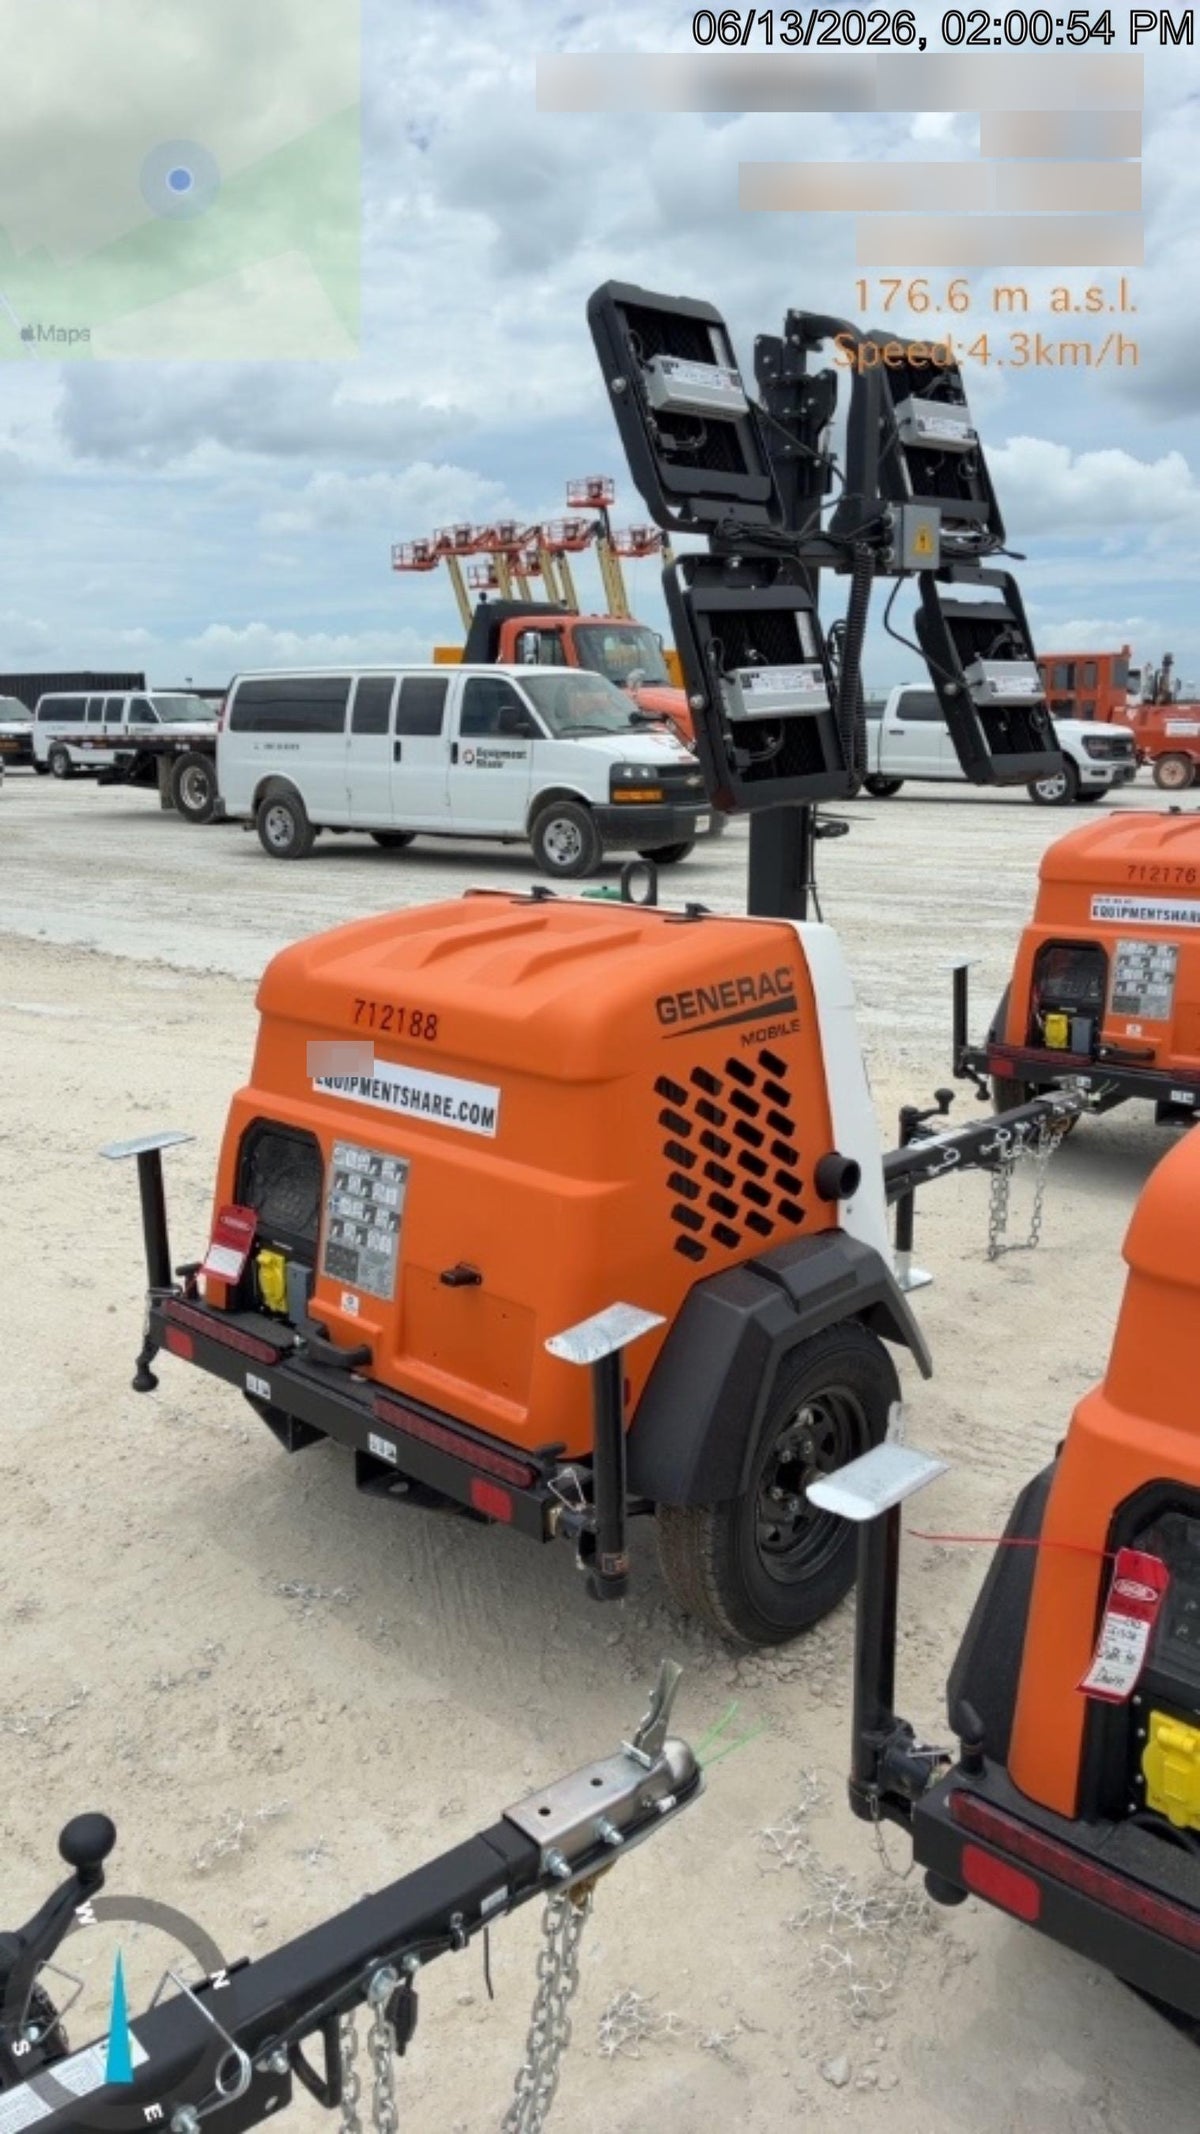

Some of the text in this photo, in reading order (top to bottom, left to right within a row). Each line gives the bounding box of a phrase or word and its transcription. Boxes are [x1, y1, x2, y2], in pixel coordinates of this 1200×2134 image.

[1127, 864, 1197, 884] 712176
[1092, 905, 1200, 923] EQUIPMENTSHAR
[655, 966, 794, 1025] GENERAC
[354, 998, 438, 1041] 712188
[740, 1018, 801, 1048] MOBILE
